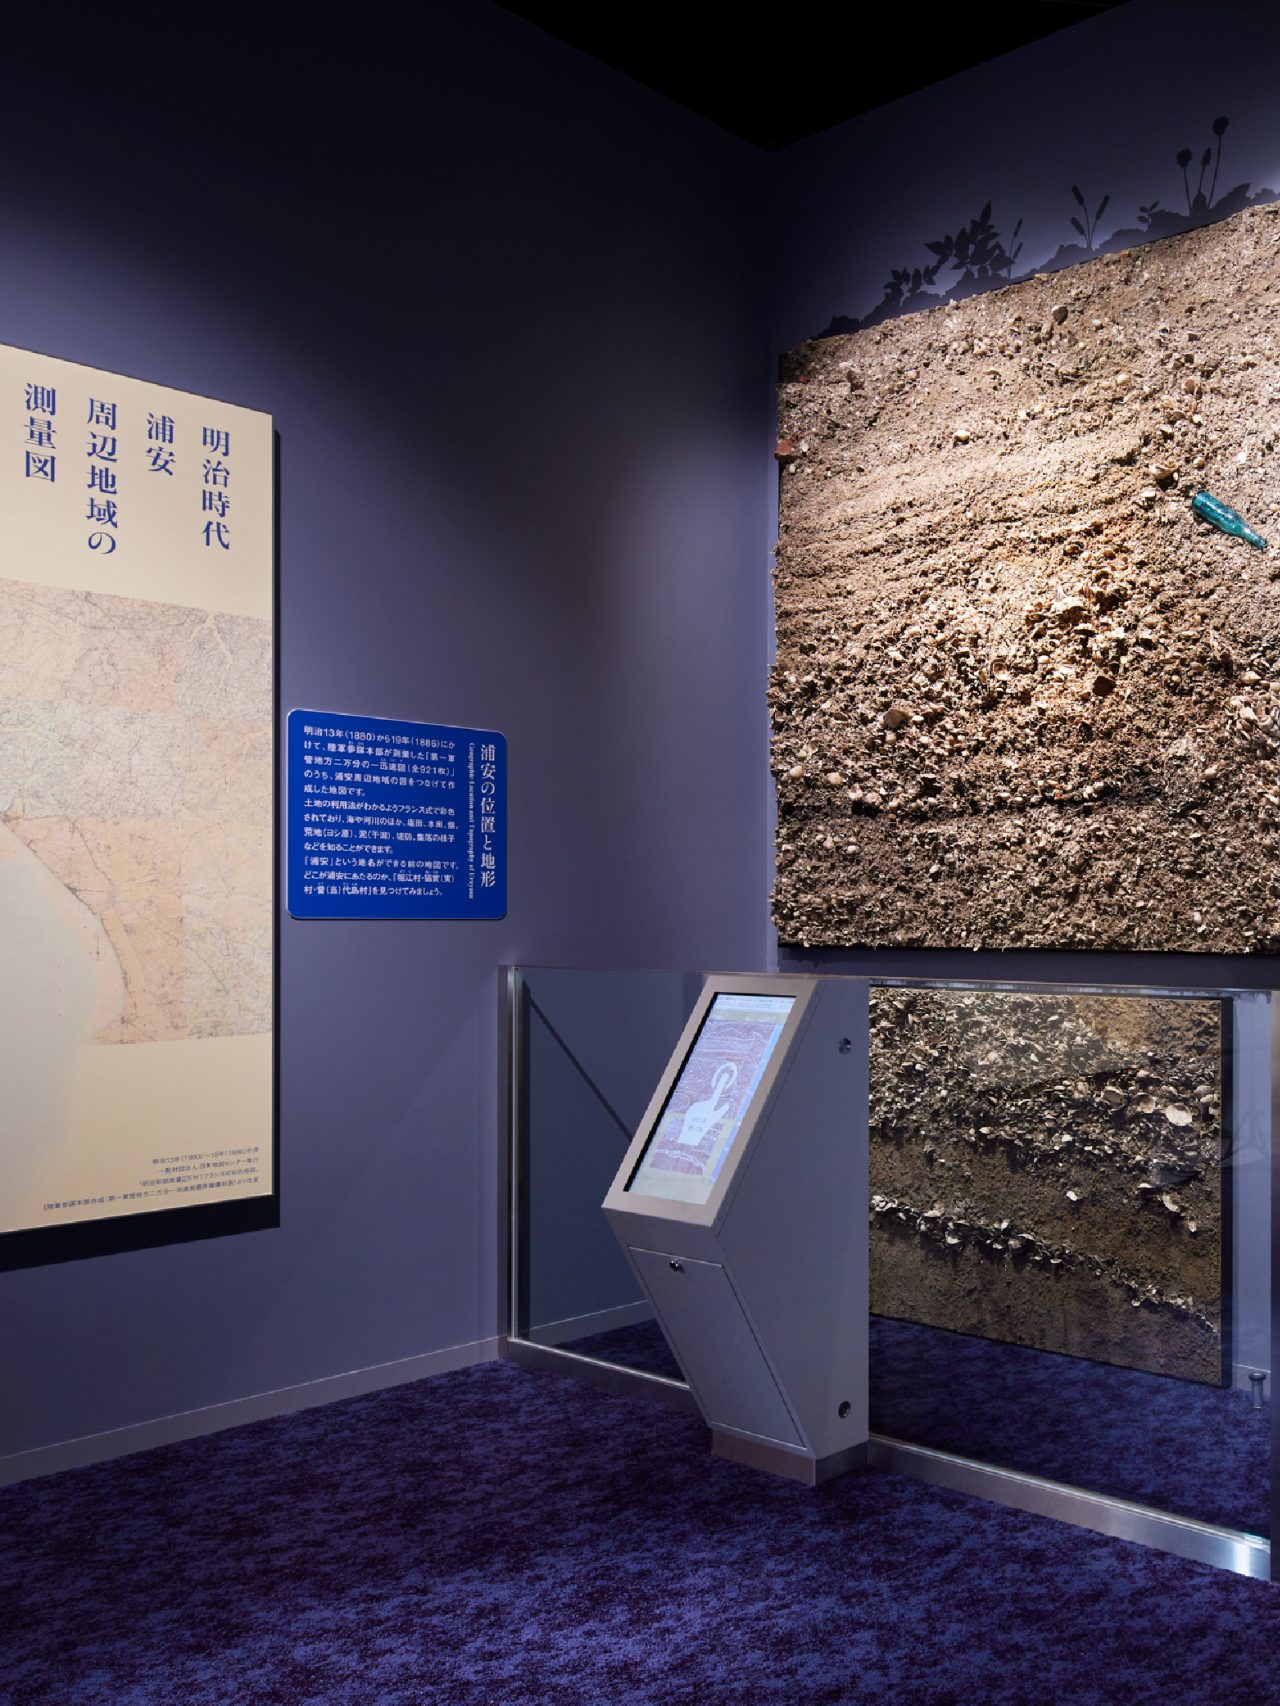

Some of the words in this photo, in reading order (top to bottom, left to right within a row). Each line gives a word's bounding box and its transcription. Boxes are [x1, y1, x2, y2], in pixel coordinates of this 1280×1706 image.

[24, 382, 57, 483] 測量図
[86, 397, 118, 555] 周辺地域の
[145, 412, 176, 476] 浦安
[202, 426, 230, 550] 明治時代
[304, 784, 366, 797] 成した地図です。
[480, 743, 496, 888] 浦安の位置と地形
